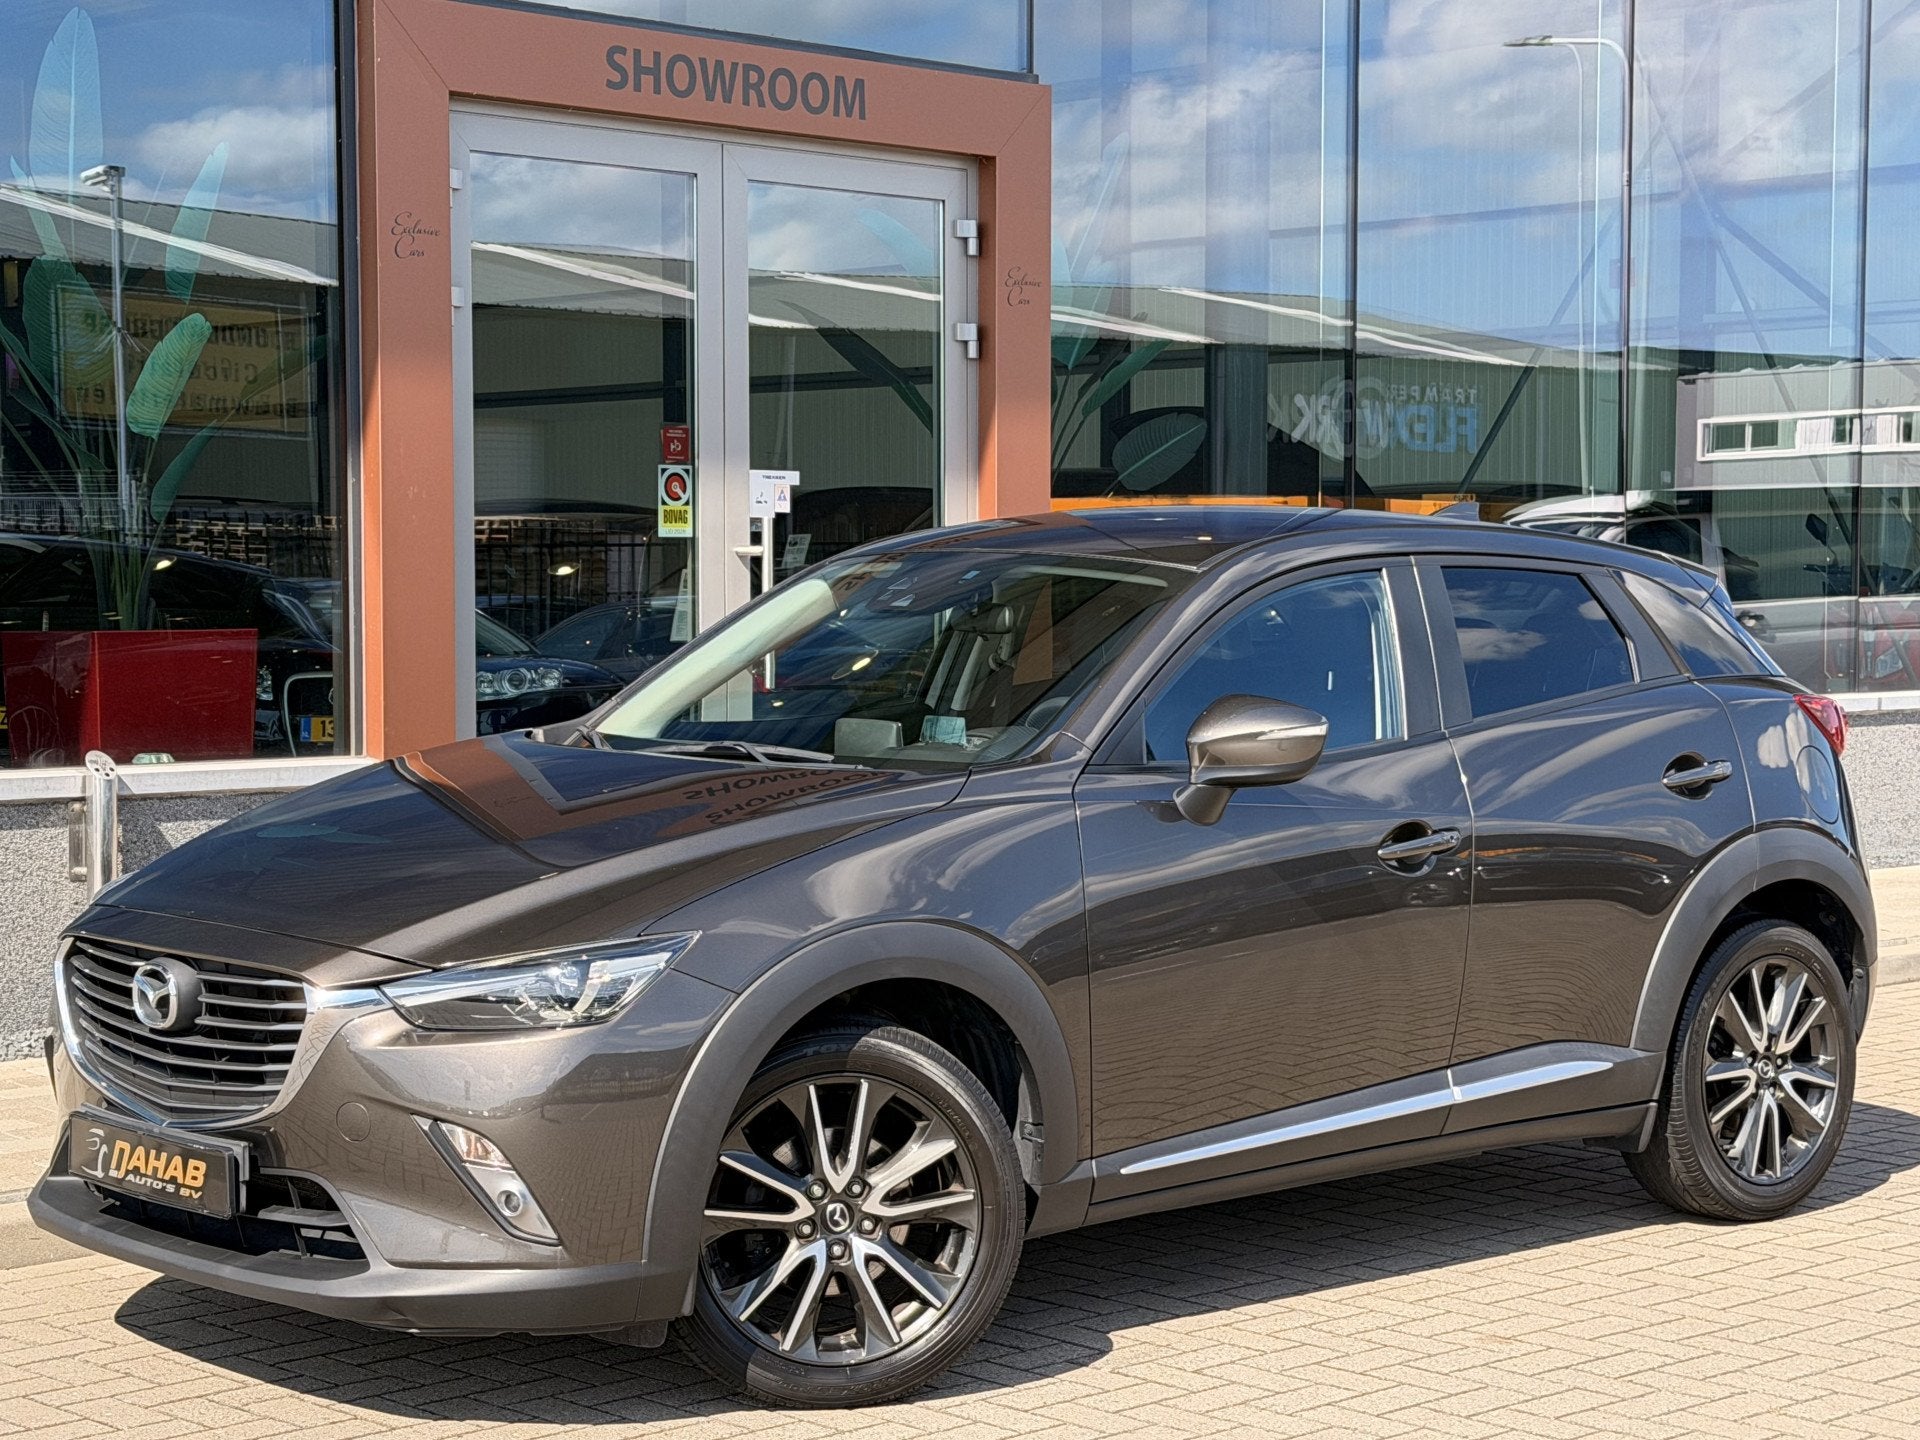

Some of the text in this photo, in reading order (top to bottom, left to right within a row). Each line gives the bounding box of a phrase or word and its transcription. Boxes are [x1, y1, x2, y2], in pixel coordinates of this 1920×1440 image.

[605, 45, 867, 121] SHOWROOM
[394, 234, 425, 259] Cars
[663, 509, 688, 525] BOVAG
[179, 1186, 203, 1200] BV
